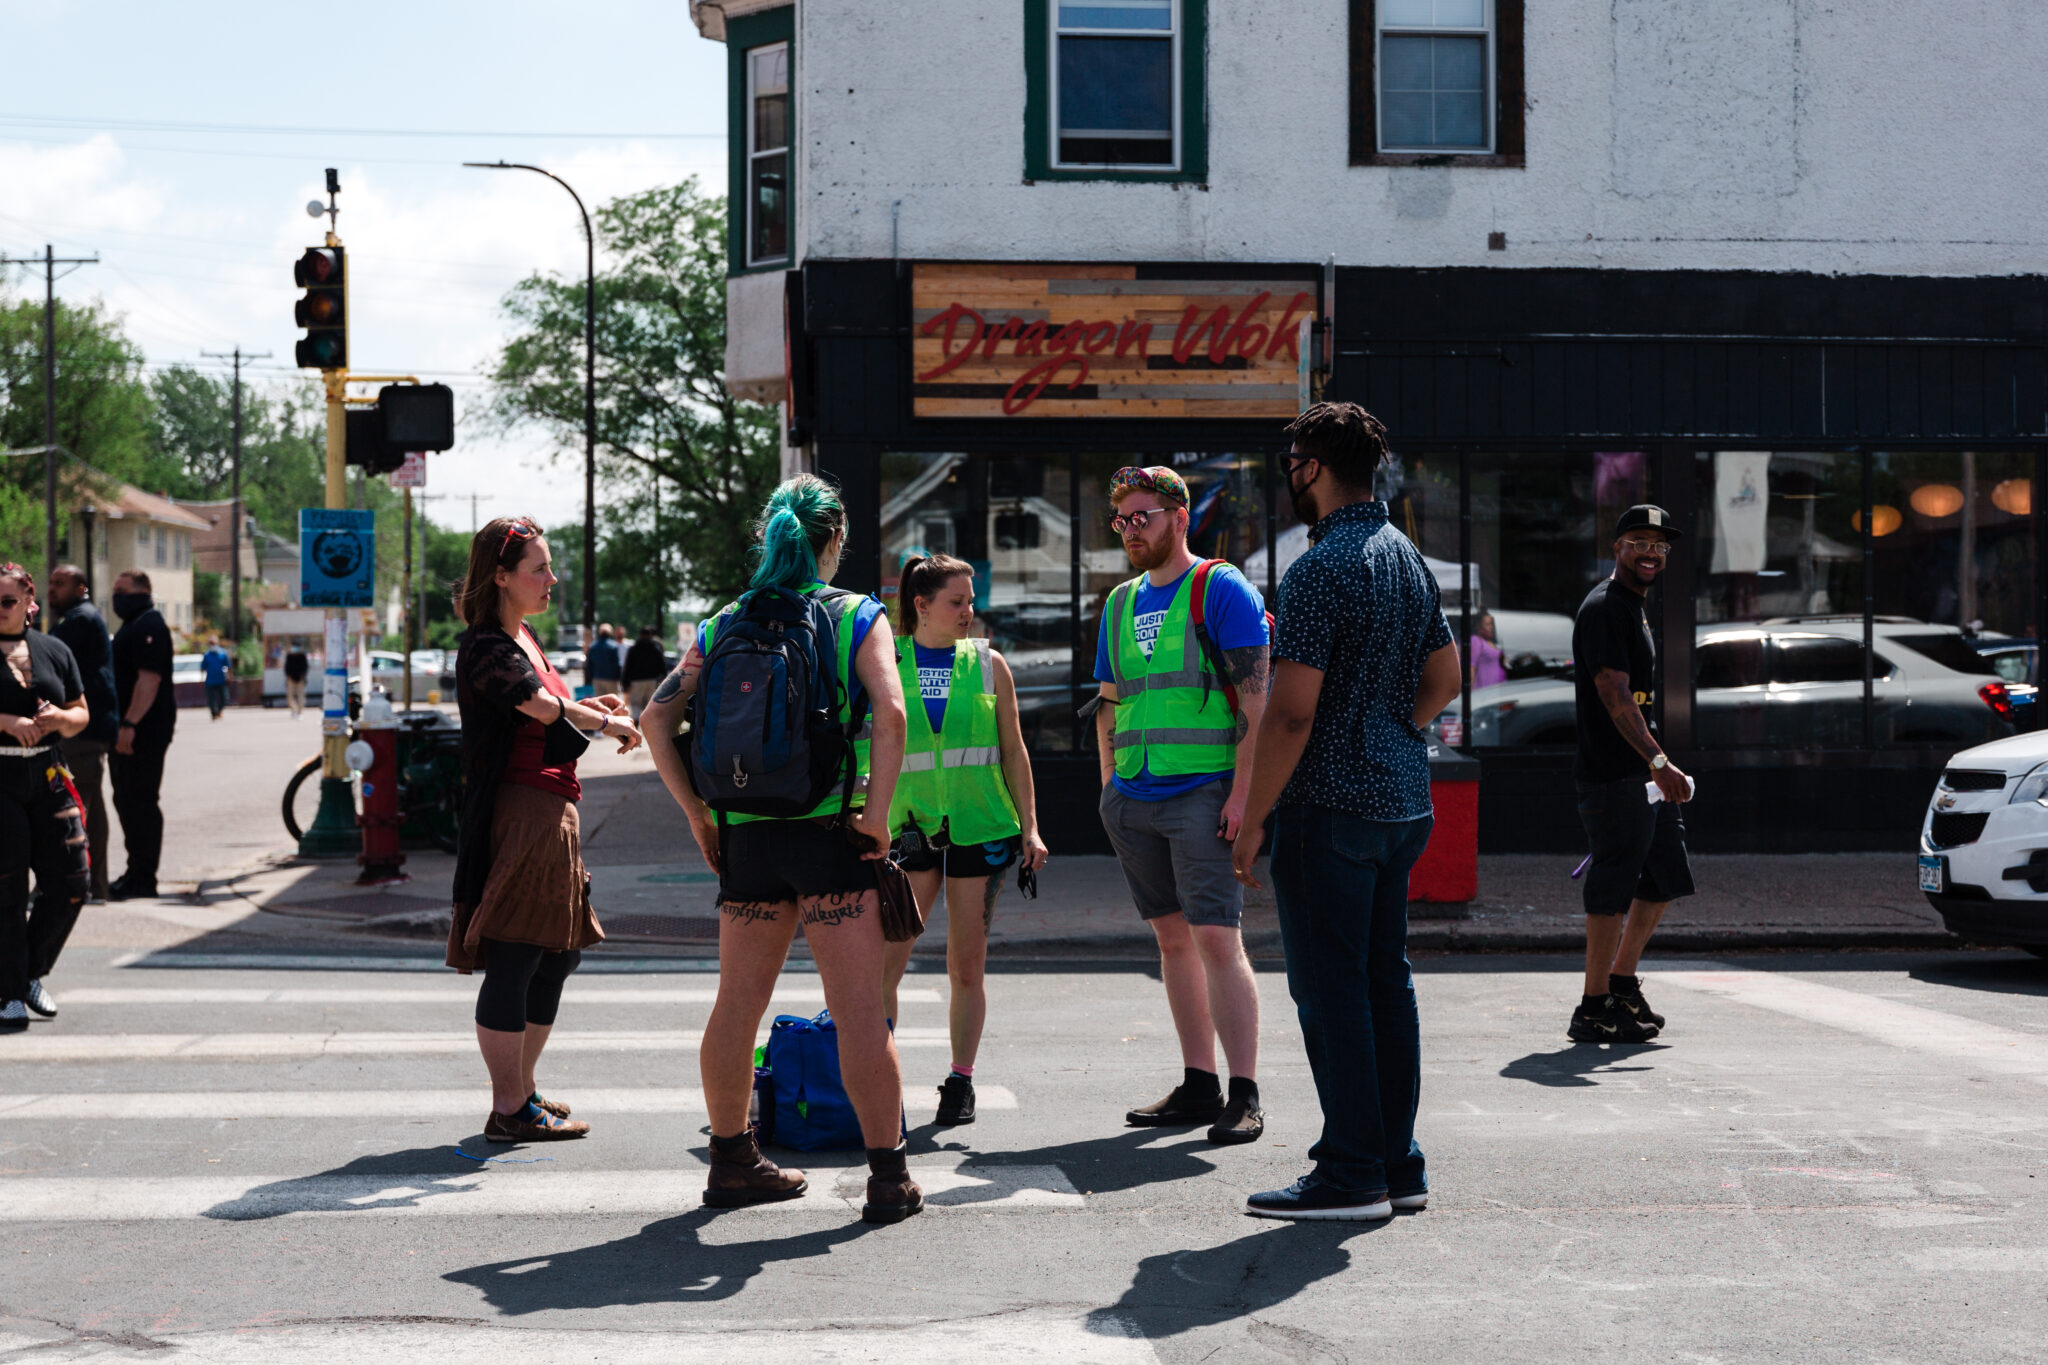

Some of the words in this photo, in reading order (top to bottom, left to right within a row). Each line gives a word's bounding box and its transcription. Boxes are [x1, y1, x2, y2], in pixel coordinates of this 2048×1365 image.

[918, 302, 1152, 416] Dragon
[1171, 291, 1309, 366] Wok
[1136, 612, 1167, 627] JUSTI
[921, 688, 942, 696] AID
